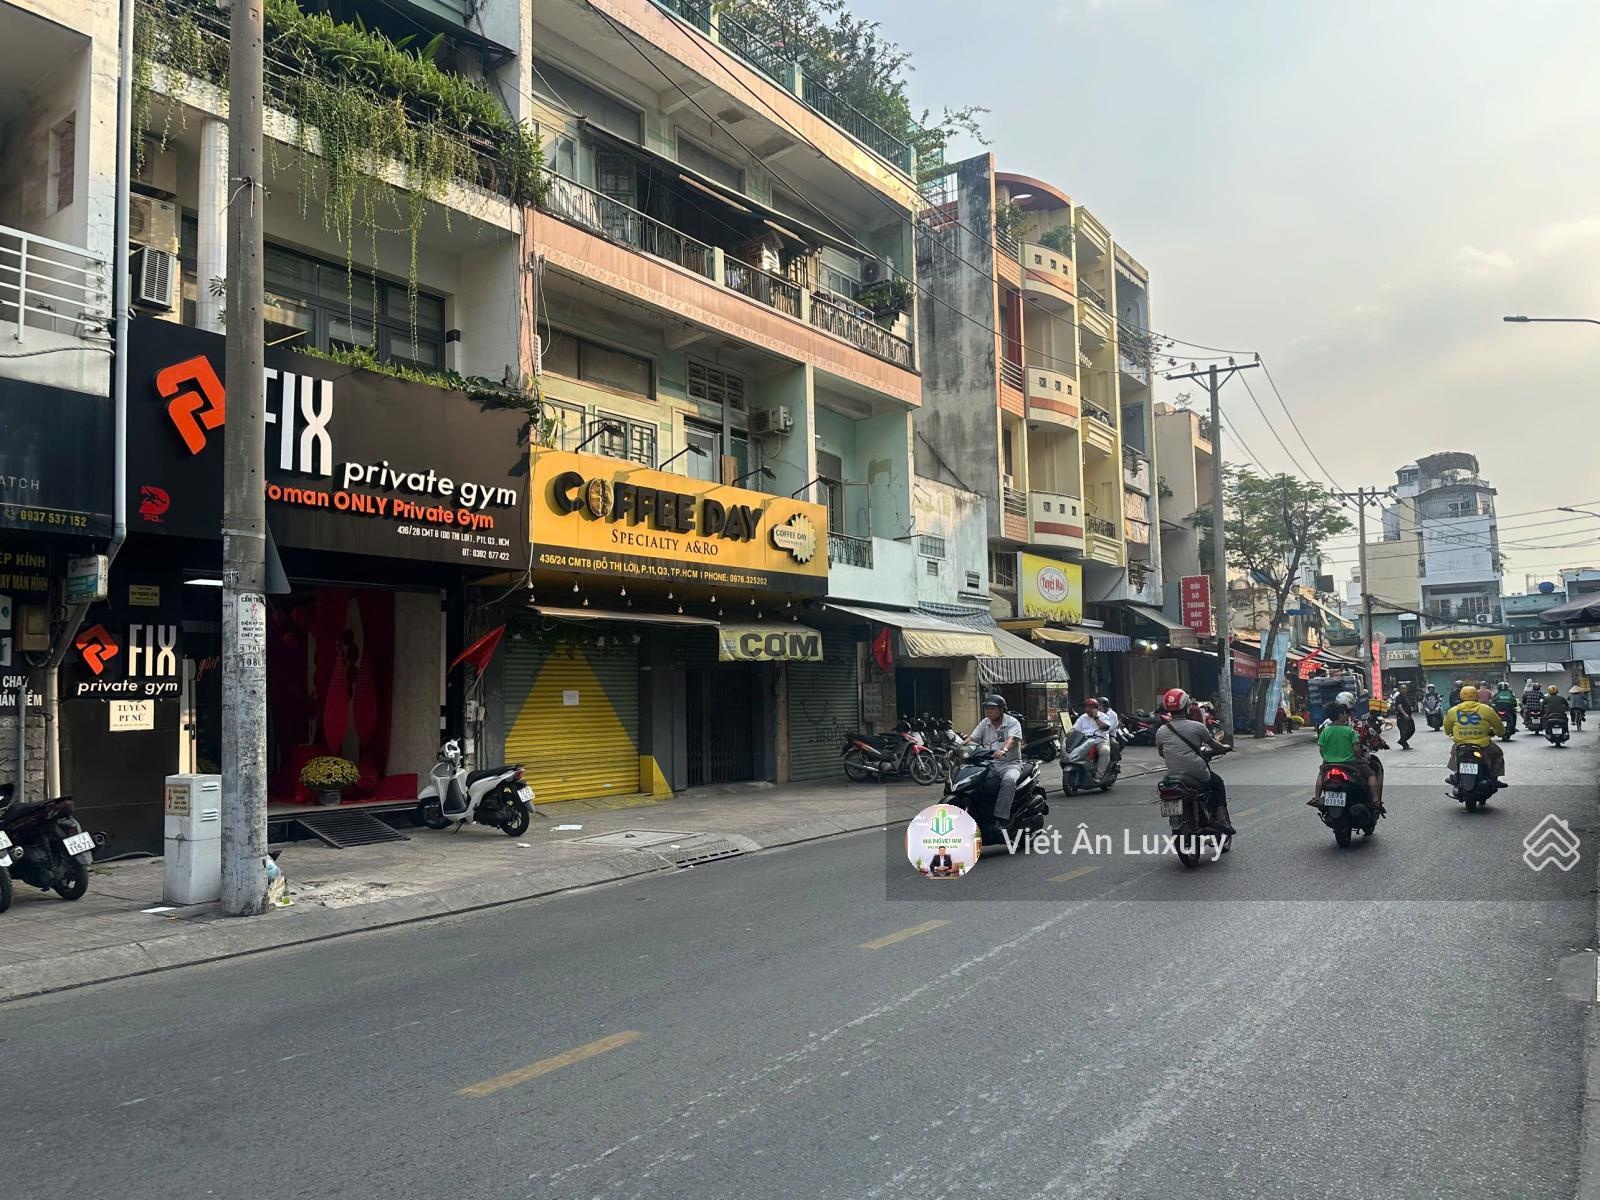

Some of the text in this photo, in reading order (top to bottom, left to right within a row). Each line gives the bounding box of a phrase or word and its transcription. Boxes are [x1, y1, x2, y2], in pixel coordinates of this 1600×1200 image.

[343, 460, 518, 510] private gym
[264, 480, 494, 530] oman ONLY Private Gym
[553, 471, 764, 541] COFFEE DAY
[20, 510, 87, 527] 0937 537 152
[775, 529, 807, 541] COFFEE DAY
[15, 551, 46, 567] KÍNH
[539, 553, 566, 566] 436/24
[568, 556, 592, 568] CMT8
[704, 571, 729, 582] PHONE:
[129, 624, 177, 676] FIX
[25, 689, 42, 706] ỀM
[77, 679, 178, 696] private gym
